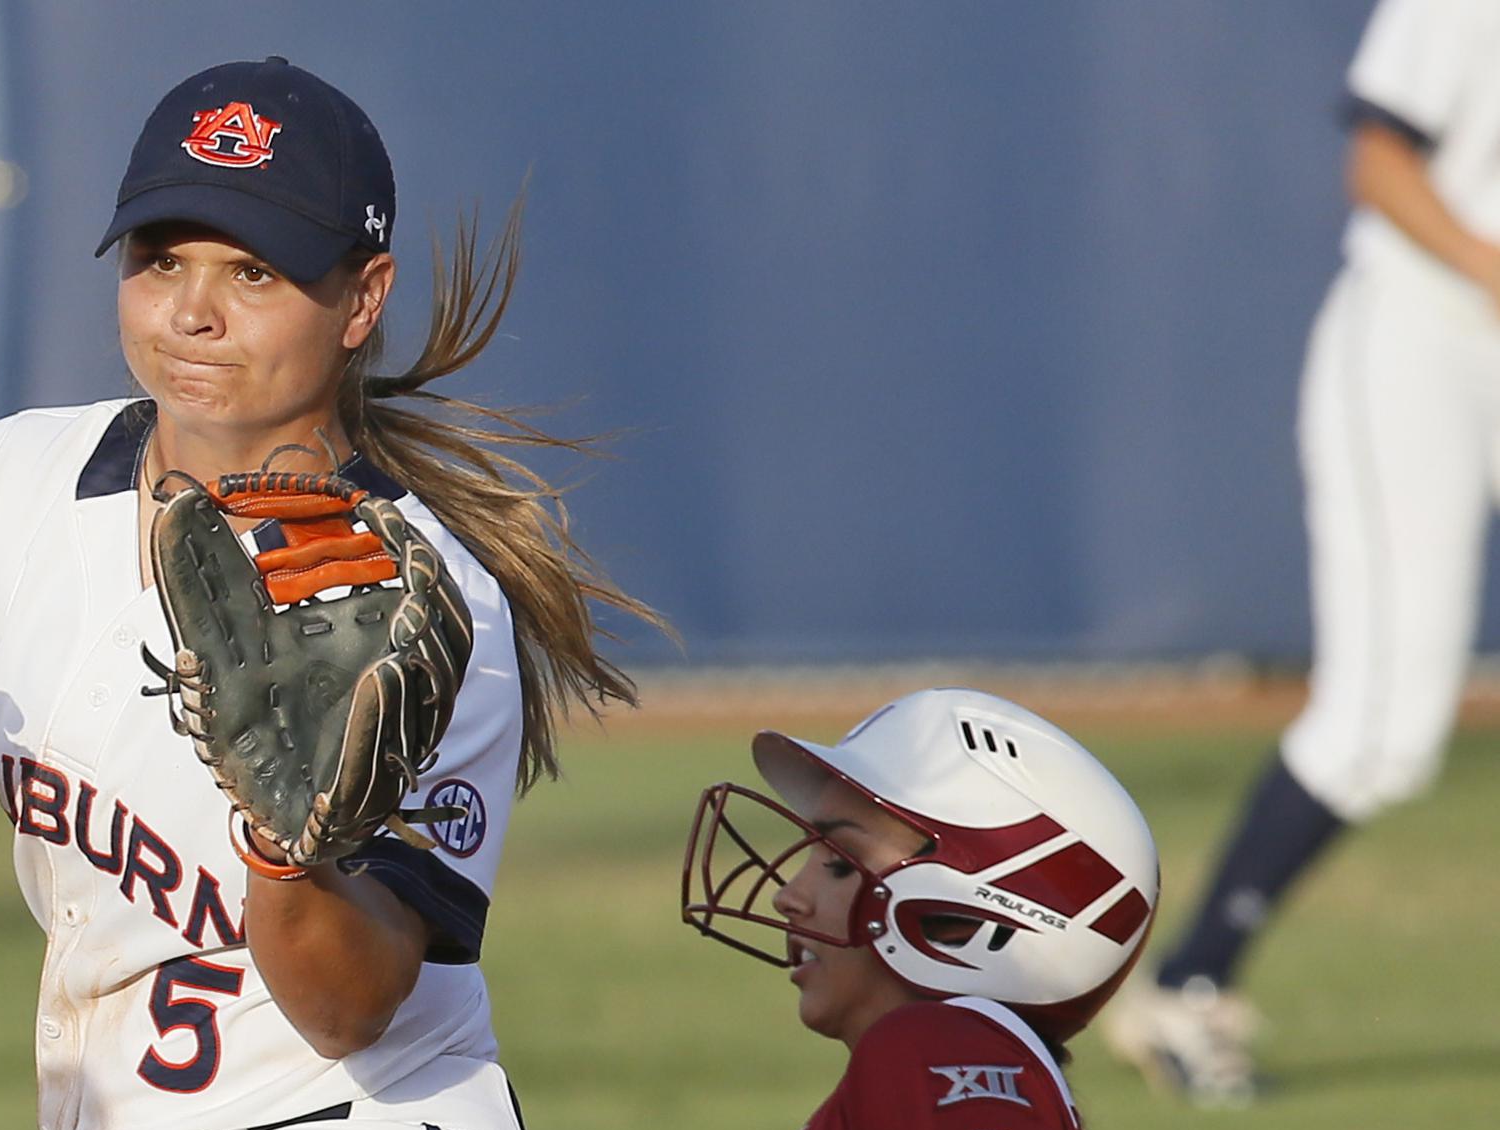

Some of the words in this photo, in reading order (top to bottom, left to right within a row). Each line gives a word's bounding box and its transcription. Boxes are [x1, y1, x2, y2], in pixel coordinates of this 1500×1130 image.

[975, 886, 1068, 932] RAWLINGS
[136, 955, 245, 1094] 5
[929, 1065, 1032, 1107] XII
